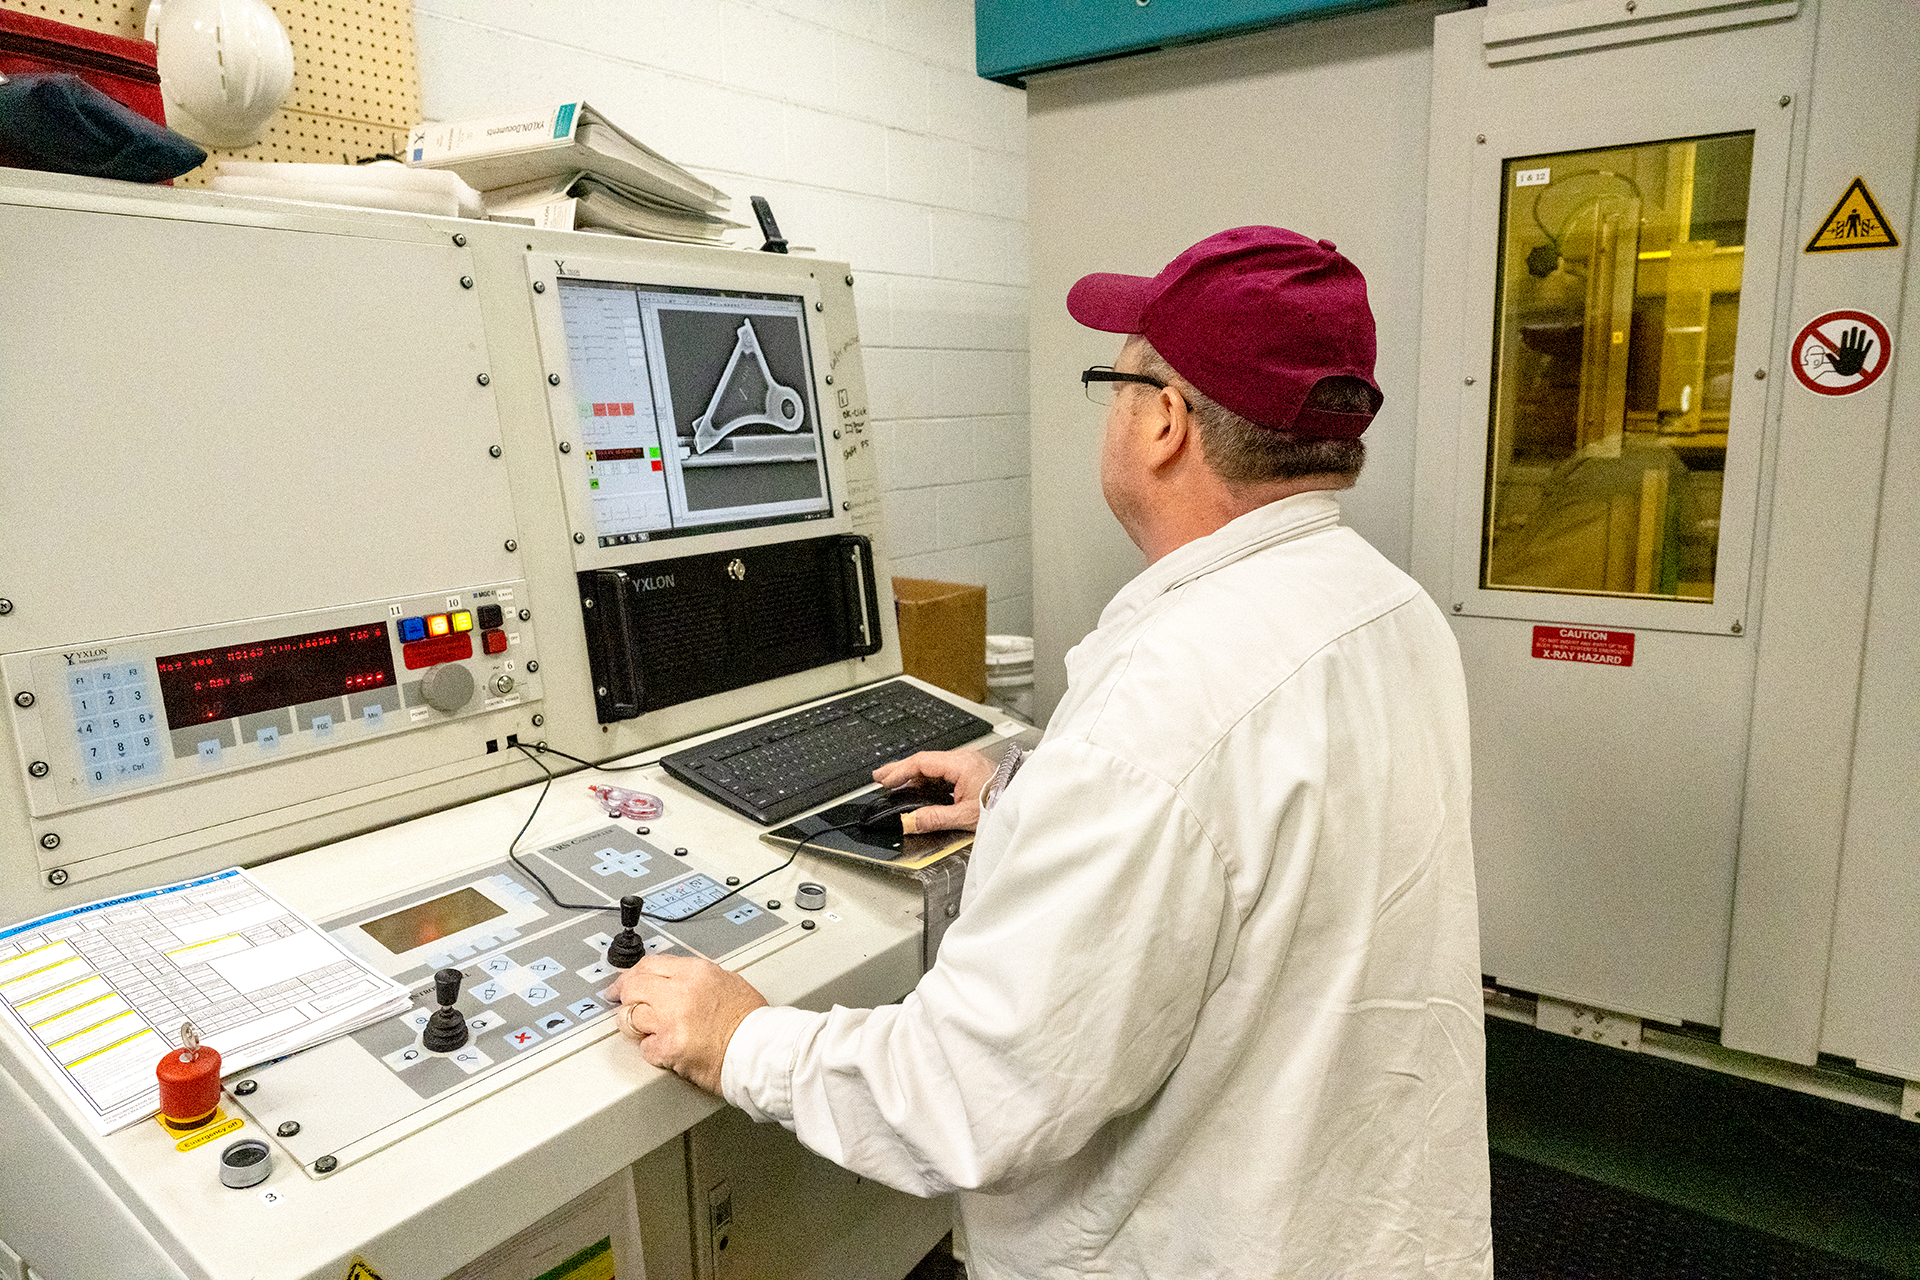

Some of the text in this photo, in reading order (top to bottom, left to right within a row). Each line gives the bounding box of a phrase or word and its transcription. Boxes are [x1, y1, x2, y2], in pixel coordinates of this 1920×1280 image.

[1536, 172, 1546, 181] 12
[632, 574, 676, 593] YXLON
[448, 600, 459, 608] 10
[390, 606, 401, 616] 11
[1559, 629, 1608, 641] CAUTION
[77, 648, 108, 660] YXLON
[1542, 649, 1622, 665] X-RAY HAZARD
[129, 668, 138, 676] F3
[108, 695, 115, 705] 2
[134, 690, 142, 701] 3
[82, 700, 87, 710] 1
[112, 718, 120, 728] 5
[139, 713, 146, 723] 6
[86, 724, 93, 733] 4
[317, 722, 329, 731] FOC
[143, 736, 151, 746] 9
[90, 747, 97, 757] 7
[117, 742, 124, 752] 8
[206, 747, 214, 756] kV
[132, 763, 145, 772] Ctrl
[95, 771, 102, 780] 0
[103, 894, 143, 908] ROCKER
[665, 895, 676, 903] F2
[682, 906, 694, 914] F4
[184, 1120, 239, 1148] Emergency off
[265, 1193, 277, 1203] 3
